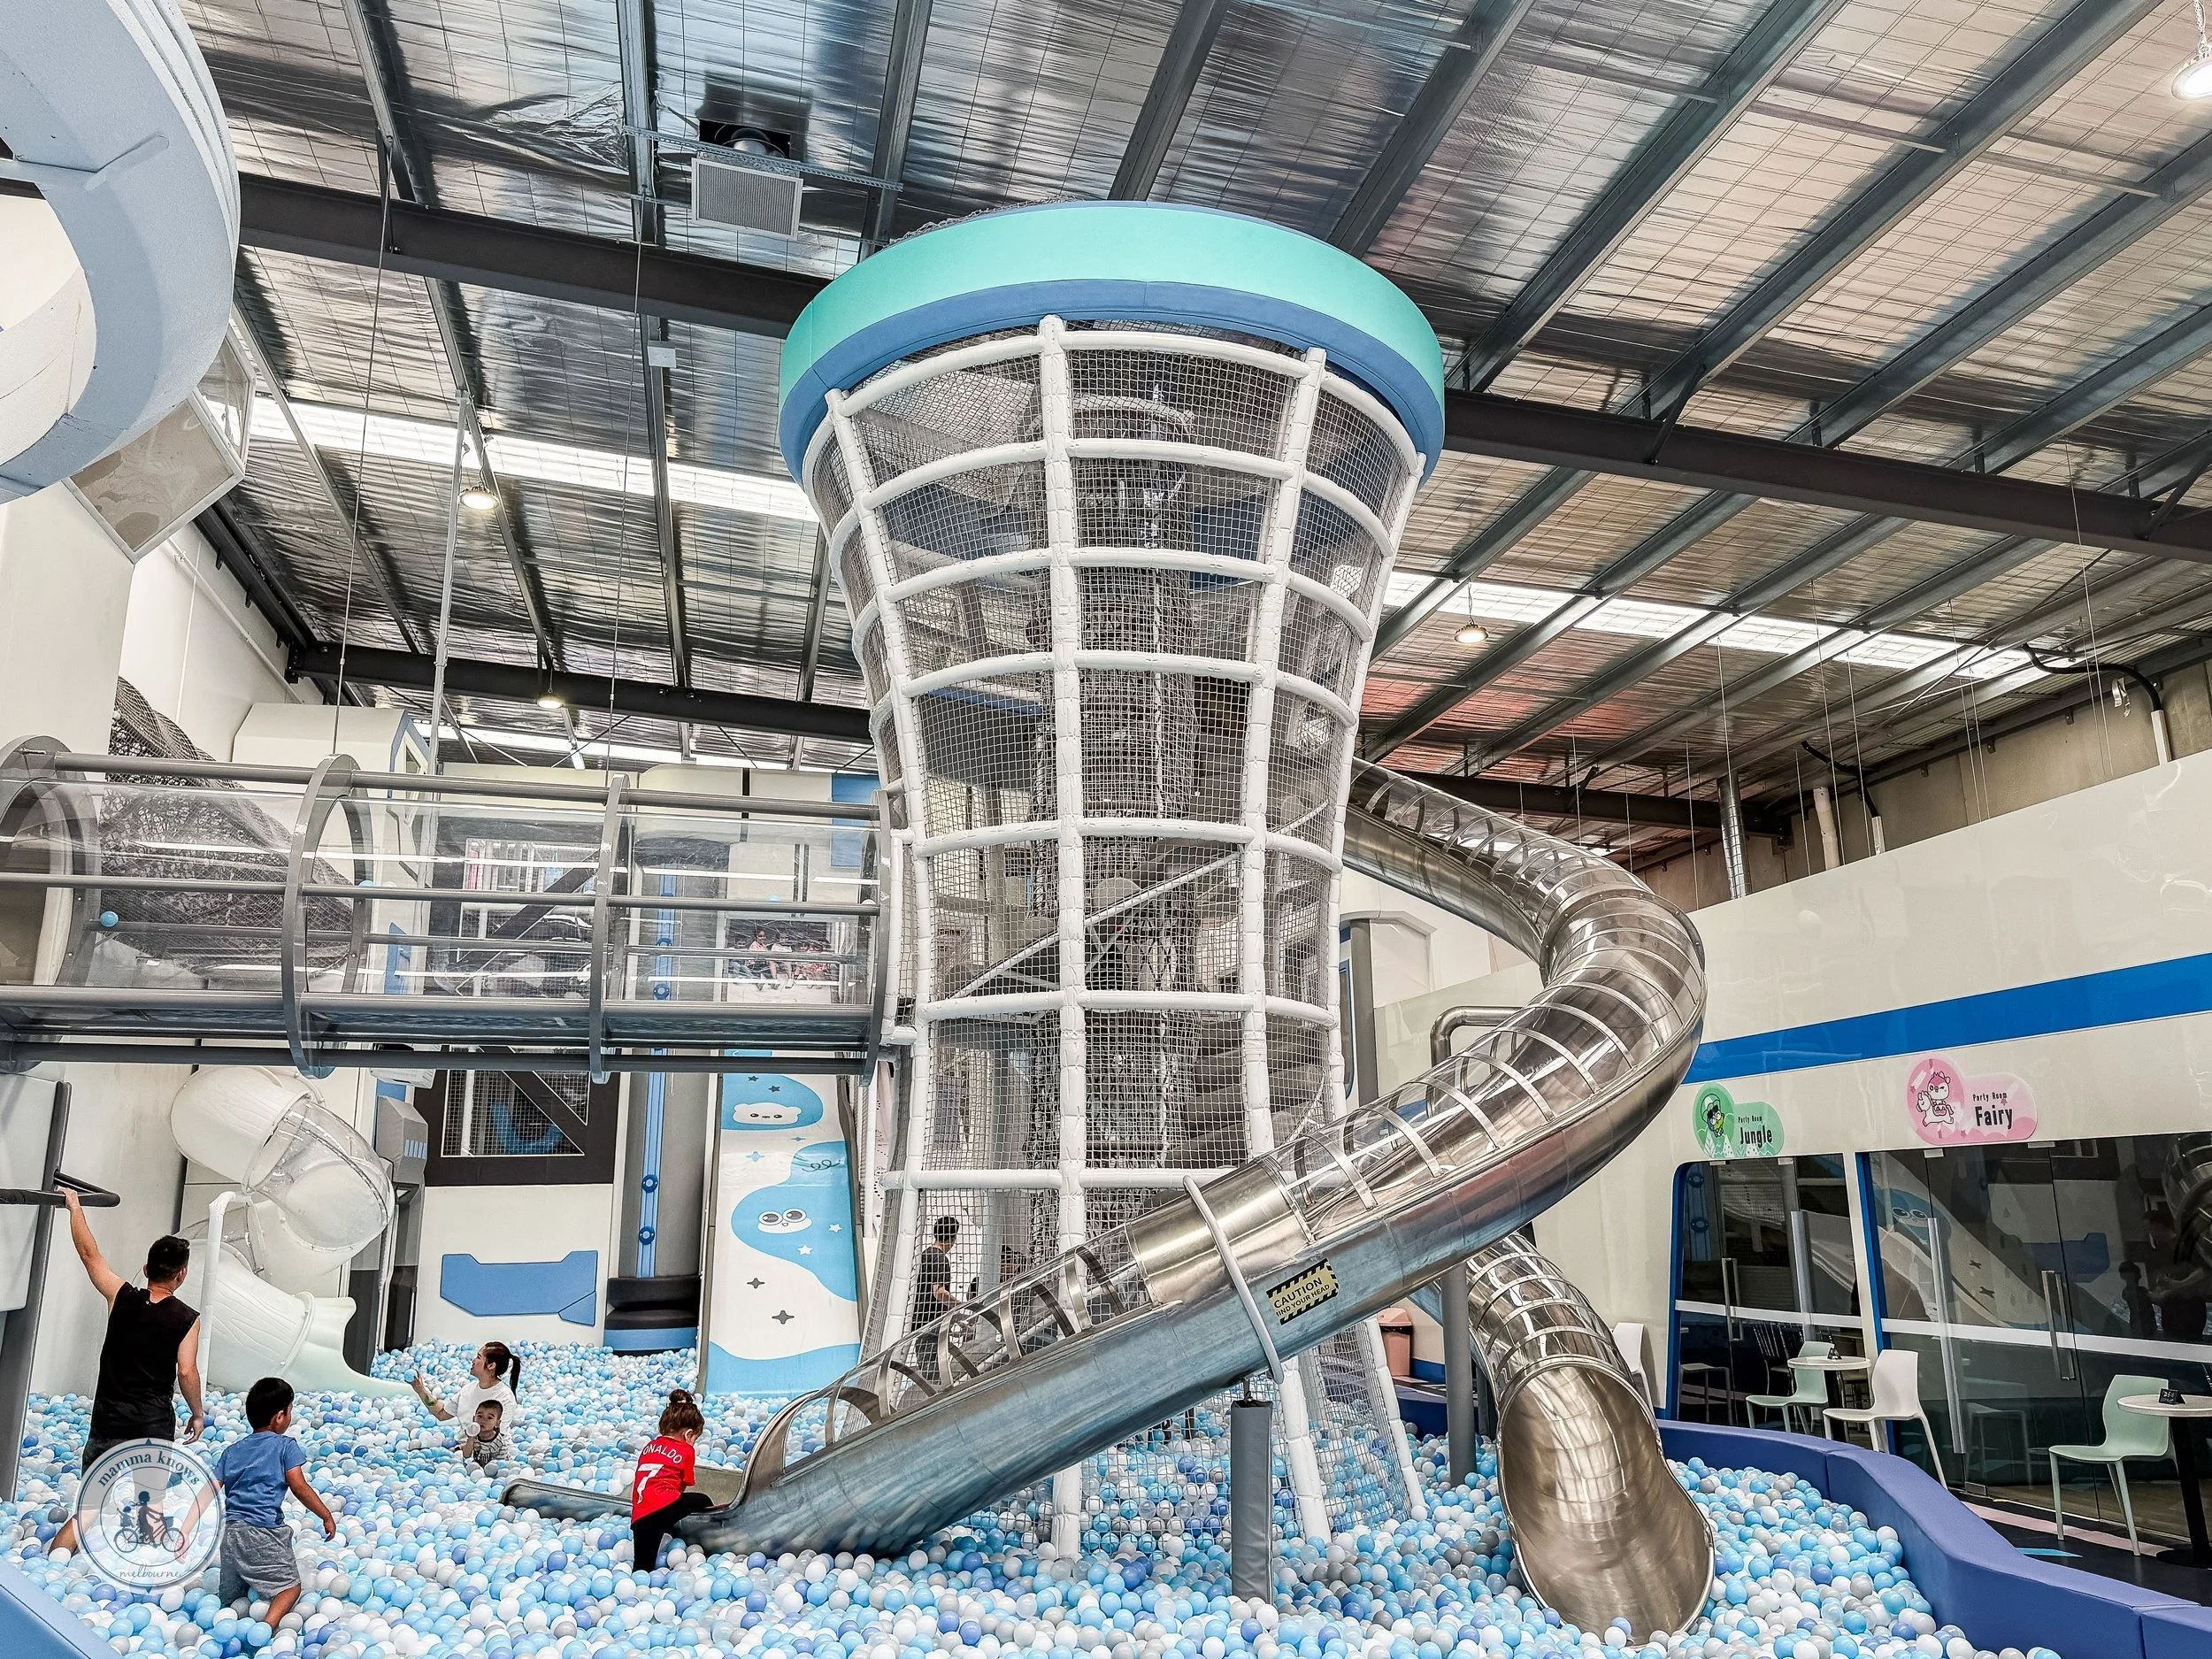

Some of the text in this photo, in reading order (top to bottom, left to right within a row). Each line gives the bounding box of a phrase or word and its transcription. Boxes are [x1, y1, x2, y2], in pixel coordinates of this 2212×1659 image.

[1972, 1094, 1989, 1102] Party
[1974, 1104, 2013, 1130] Fairy
[1740, 1125, 1772, 1148] Jungle
[1273, 1277, 1323, 1309] CAUTION
[1292, 1294, 1311, 1308] YOUR
[1311, 1284, 1330, 1298] HEAD
[641, 1443, 683, 1463] ONALDO
[636, 1463, 664, 1505] 7
